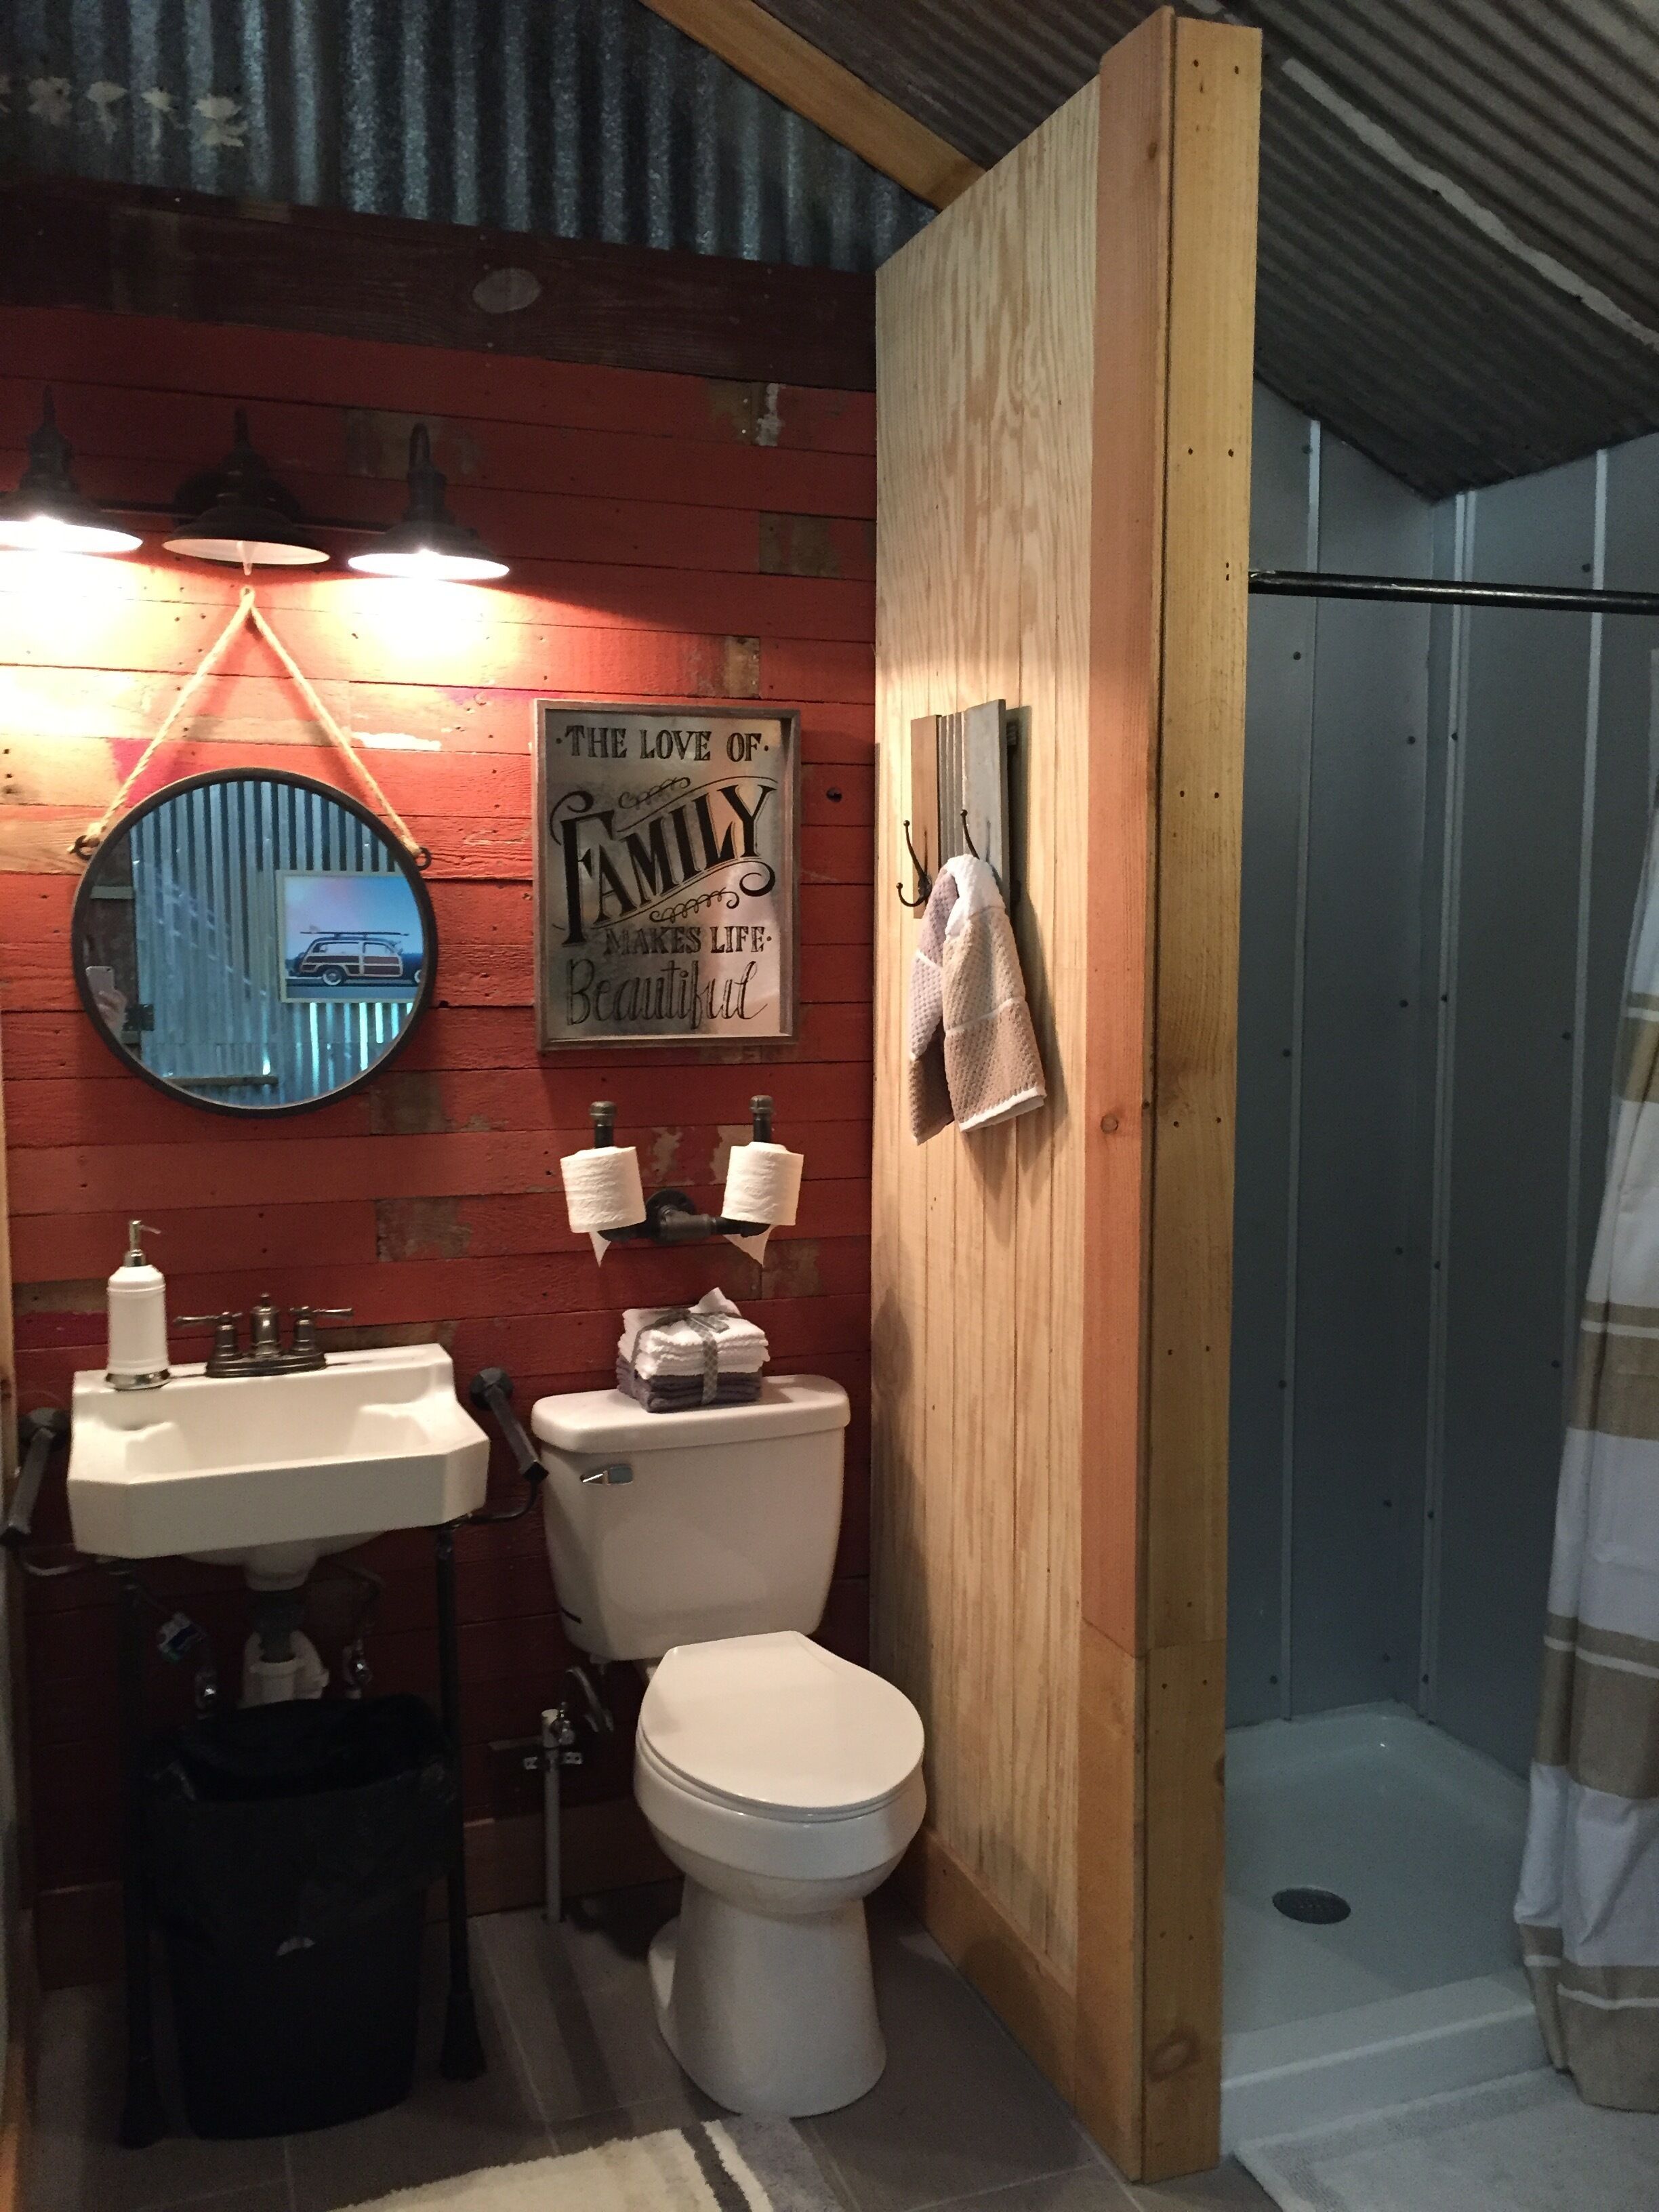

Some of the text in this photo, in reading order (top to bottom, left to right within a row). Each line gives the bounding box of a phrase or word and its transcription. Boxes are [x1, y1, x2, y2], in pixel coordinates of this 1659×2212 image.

[565, 725, 762, 762] THE LOVE OF
[550, 784, 777, 946] FAMILY
[606, 926, 766, 954] MAKES LIFE
[567, 958, 768, 1029] Beautiful
